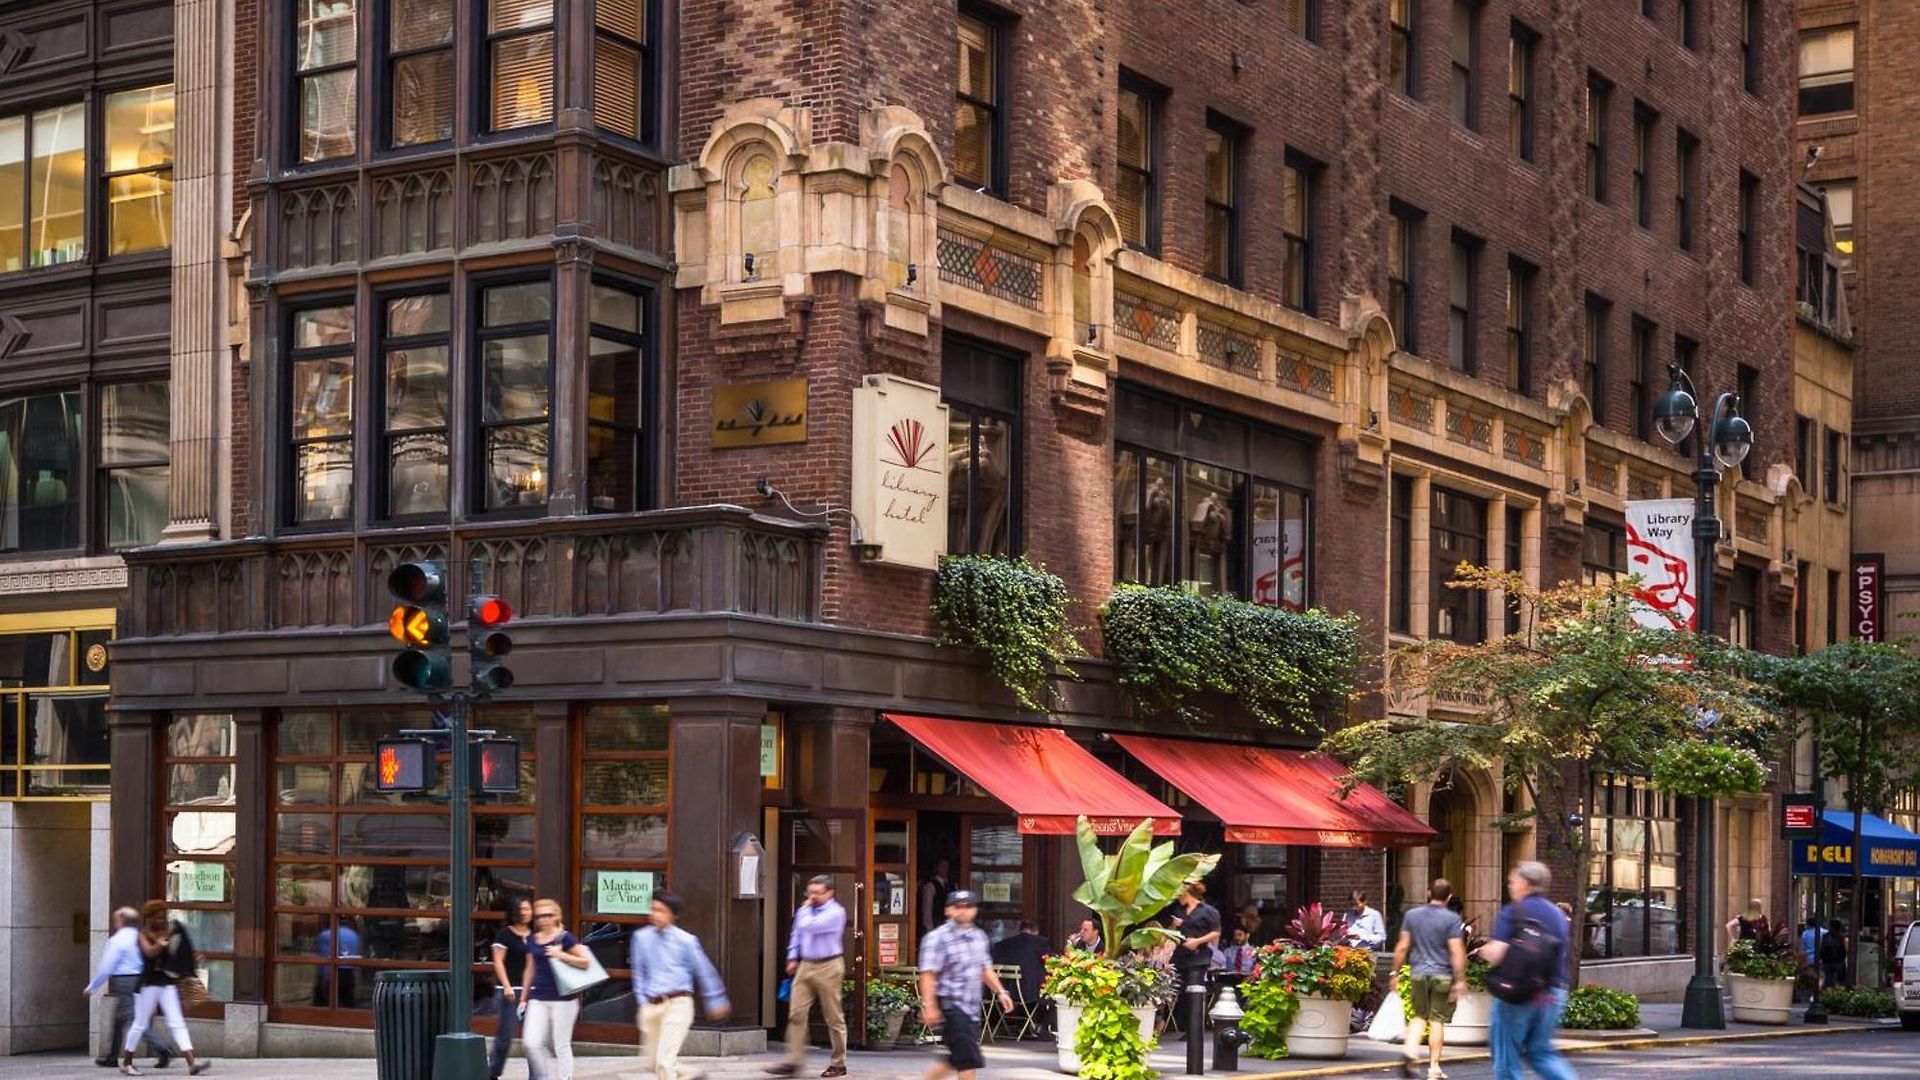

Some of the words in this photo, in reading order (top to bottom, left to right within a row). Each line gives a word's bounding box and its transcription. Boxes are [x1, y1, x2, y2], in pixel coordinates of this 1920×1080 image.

[880, 470, 940, 512] library
[882, 498, 925, 524] hotel
[1647, 514, 1690, 526] Library
[1647, 527, 1673, 540] Way
[1807, 845, 1852, 863] DELI
[602, 879, 649, 891] Madison
[618, 890, 643, 903] Vine
[893, 892, 901, 908] A
